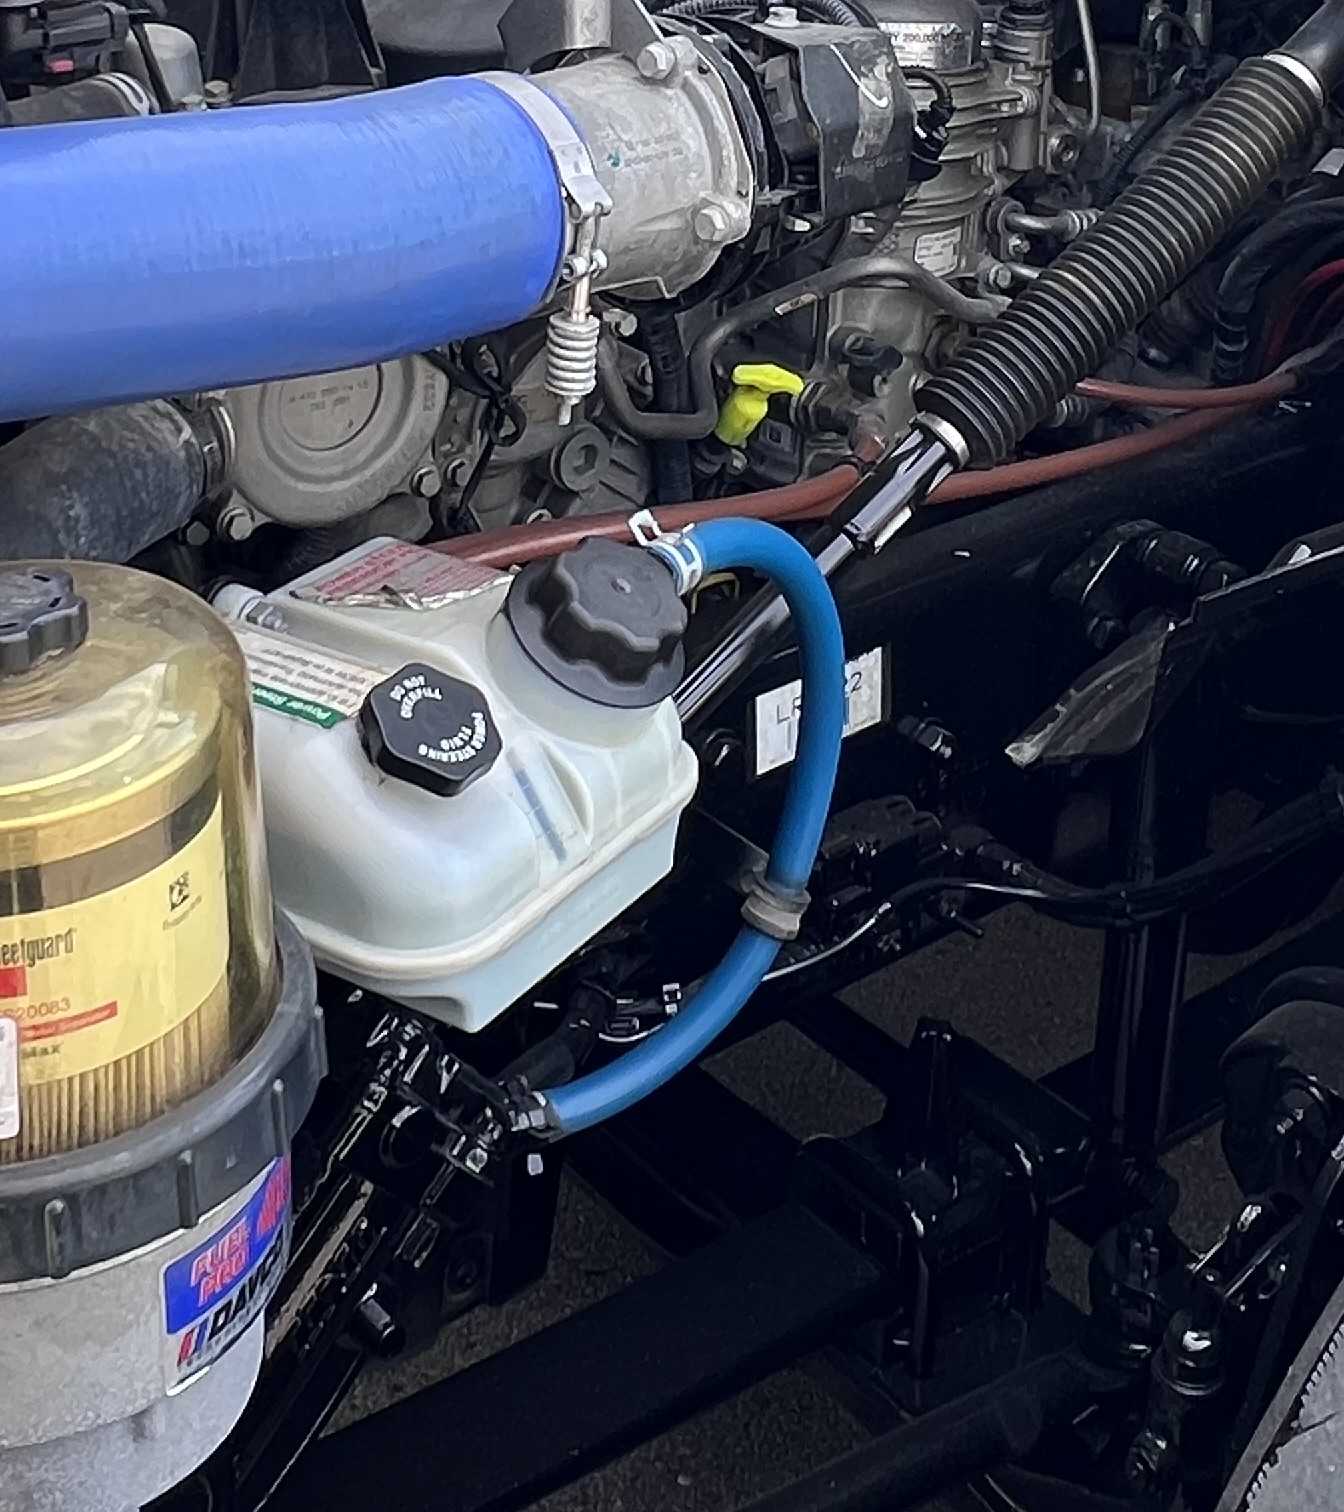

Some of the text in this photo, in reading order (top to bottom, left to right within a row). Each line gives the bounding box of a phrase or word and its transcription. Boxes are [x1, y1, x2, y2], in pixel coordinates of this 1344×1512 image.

[389, 675, 425, 701] DO NOT
[400, 686, 442, 719] OVERFILL
[418, 712, 486, 764] POWER STEERING
[440, 725, 472, 751] FLUID
[198, 1250, 251, 1308] PRO
